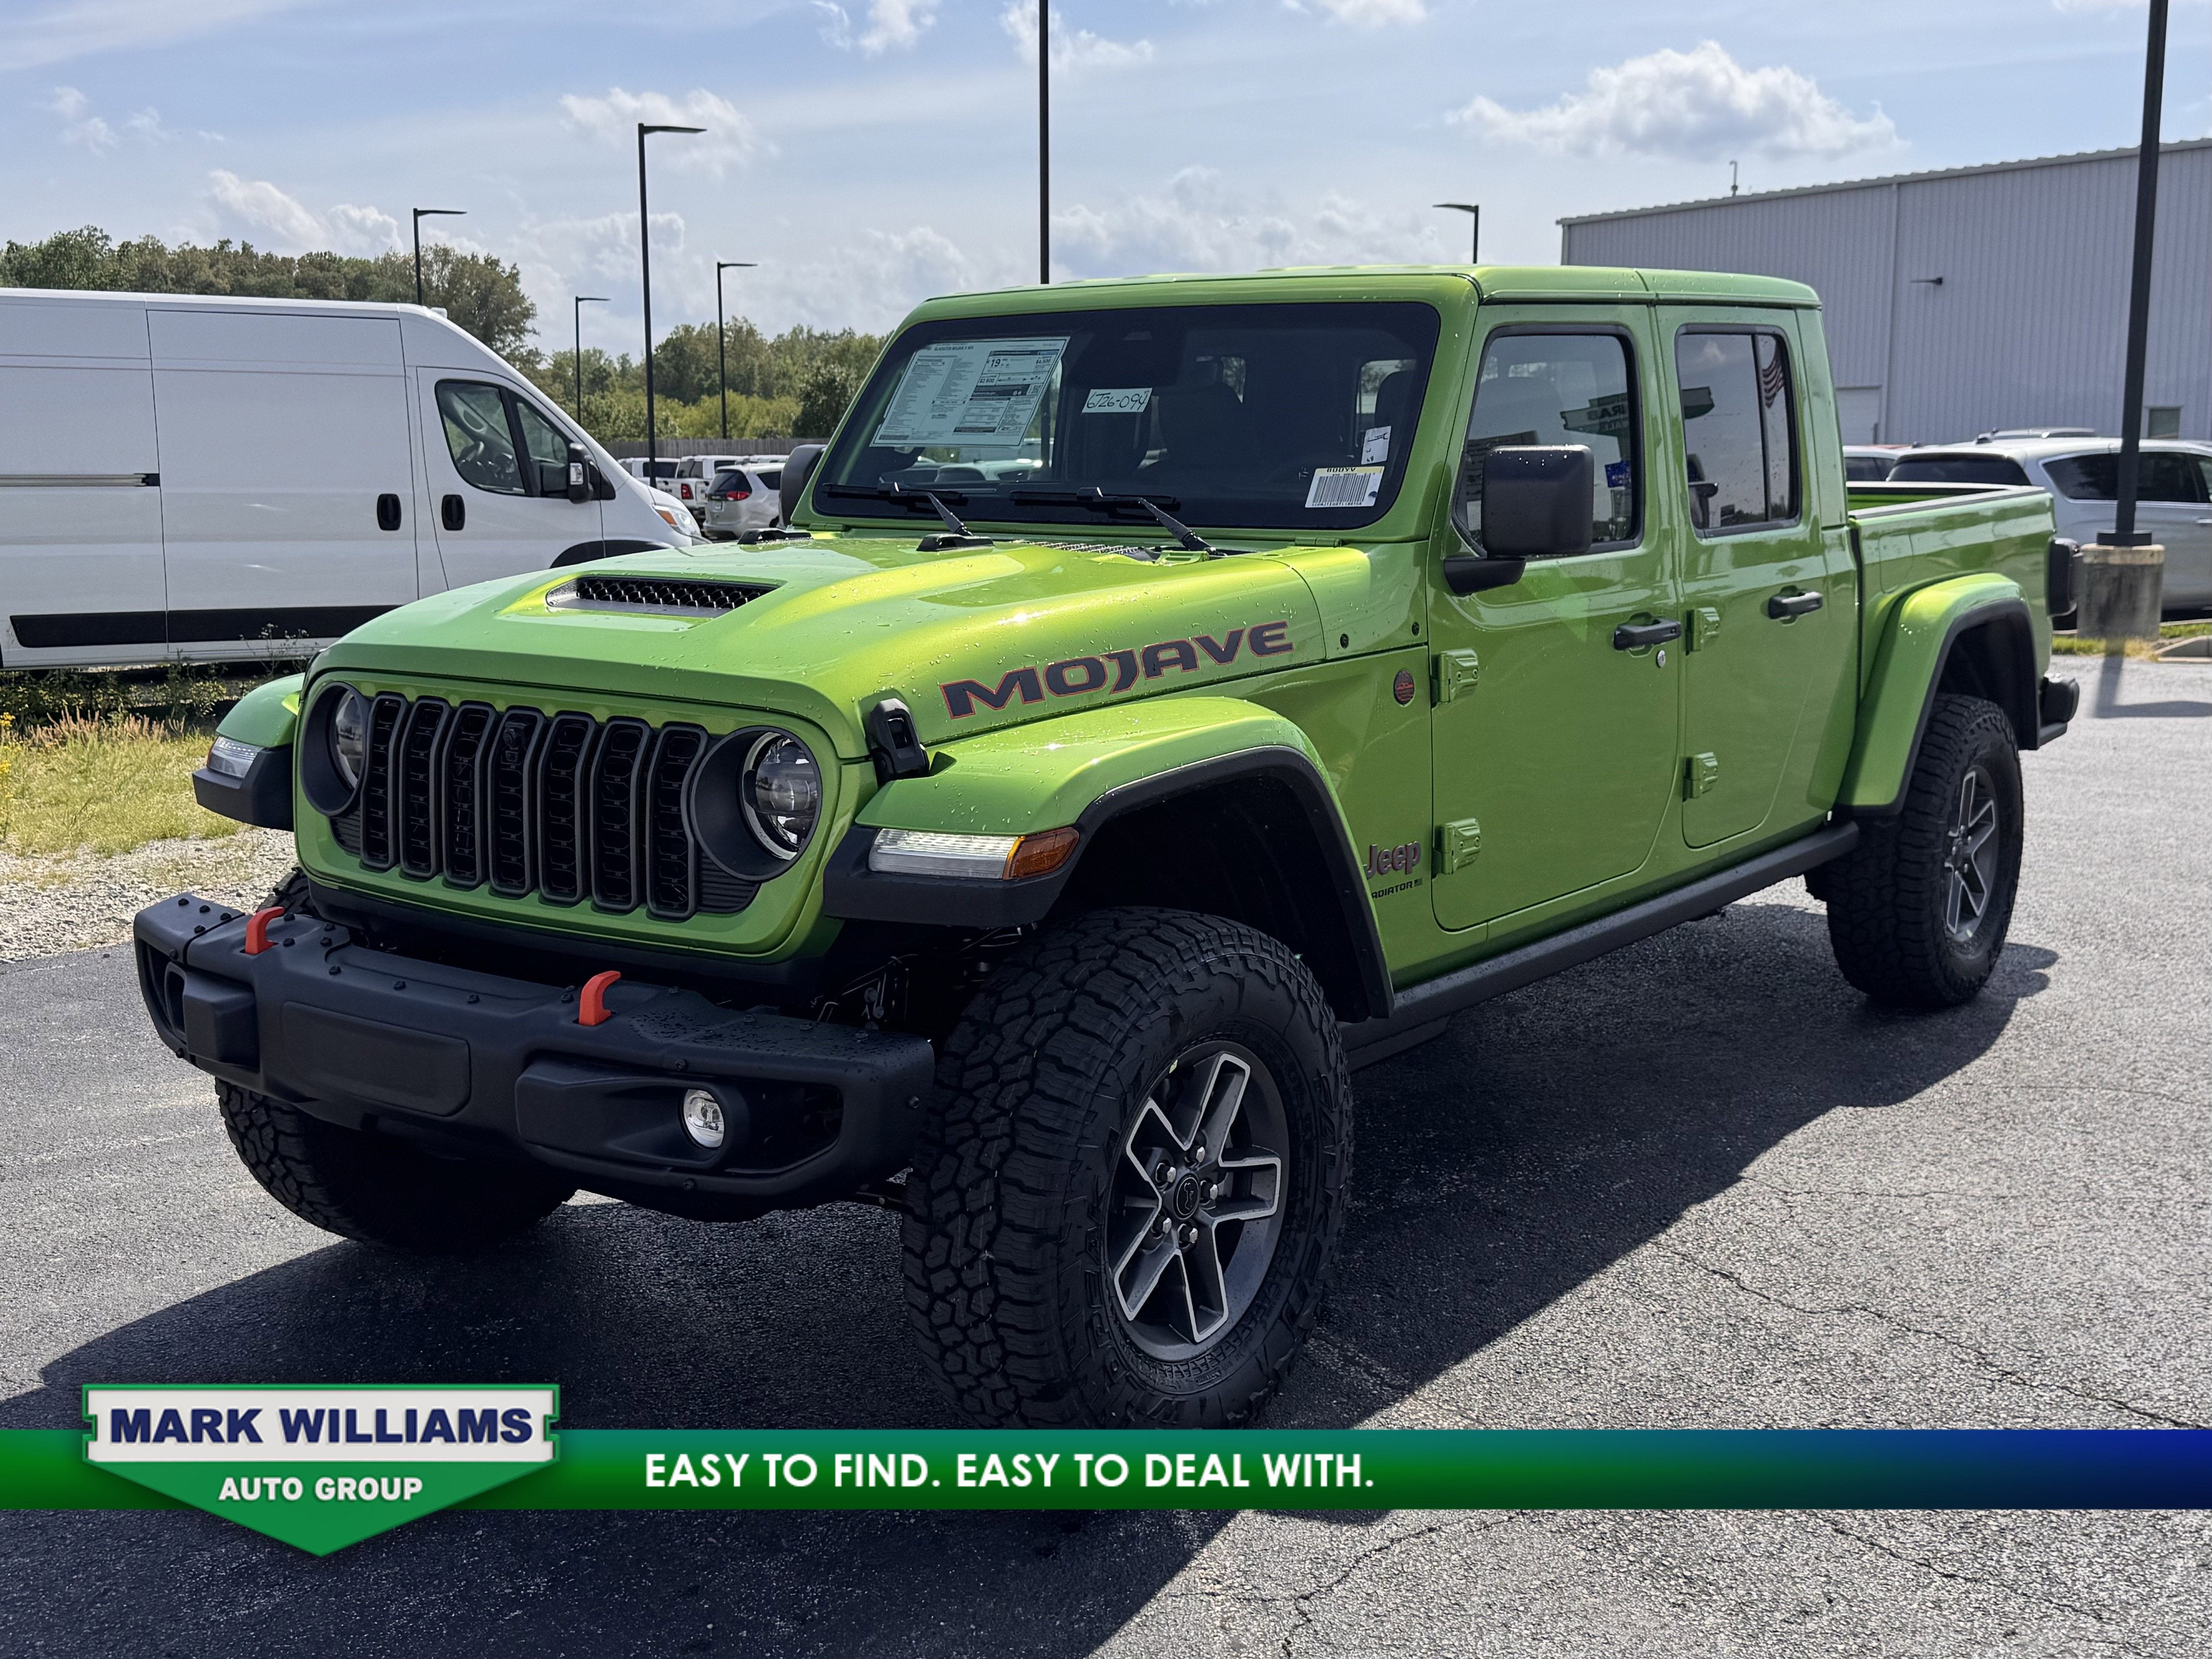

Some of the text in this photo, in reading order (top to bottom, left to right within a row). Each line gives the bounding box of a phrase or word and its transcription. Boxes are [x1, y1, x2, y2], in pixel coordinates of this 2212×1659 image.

[991, 358, 1001, 368] 19
[940, 621, 1294, 719] MOJAVE
[1363, 841, 1421, 879] Jeep
